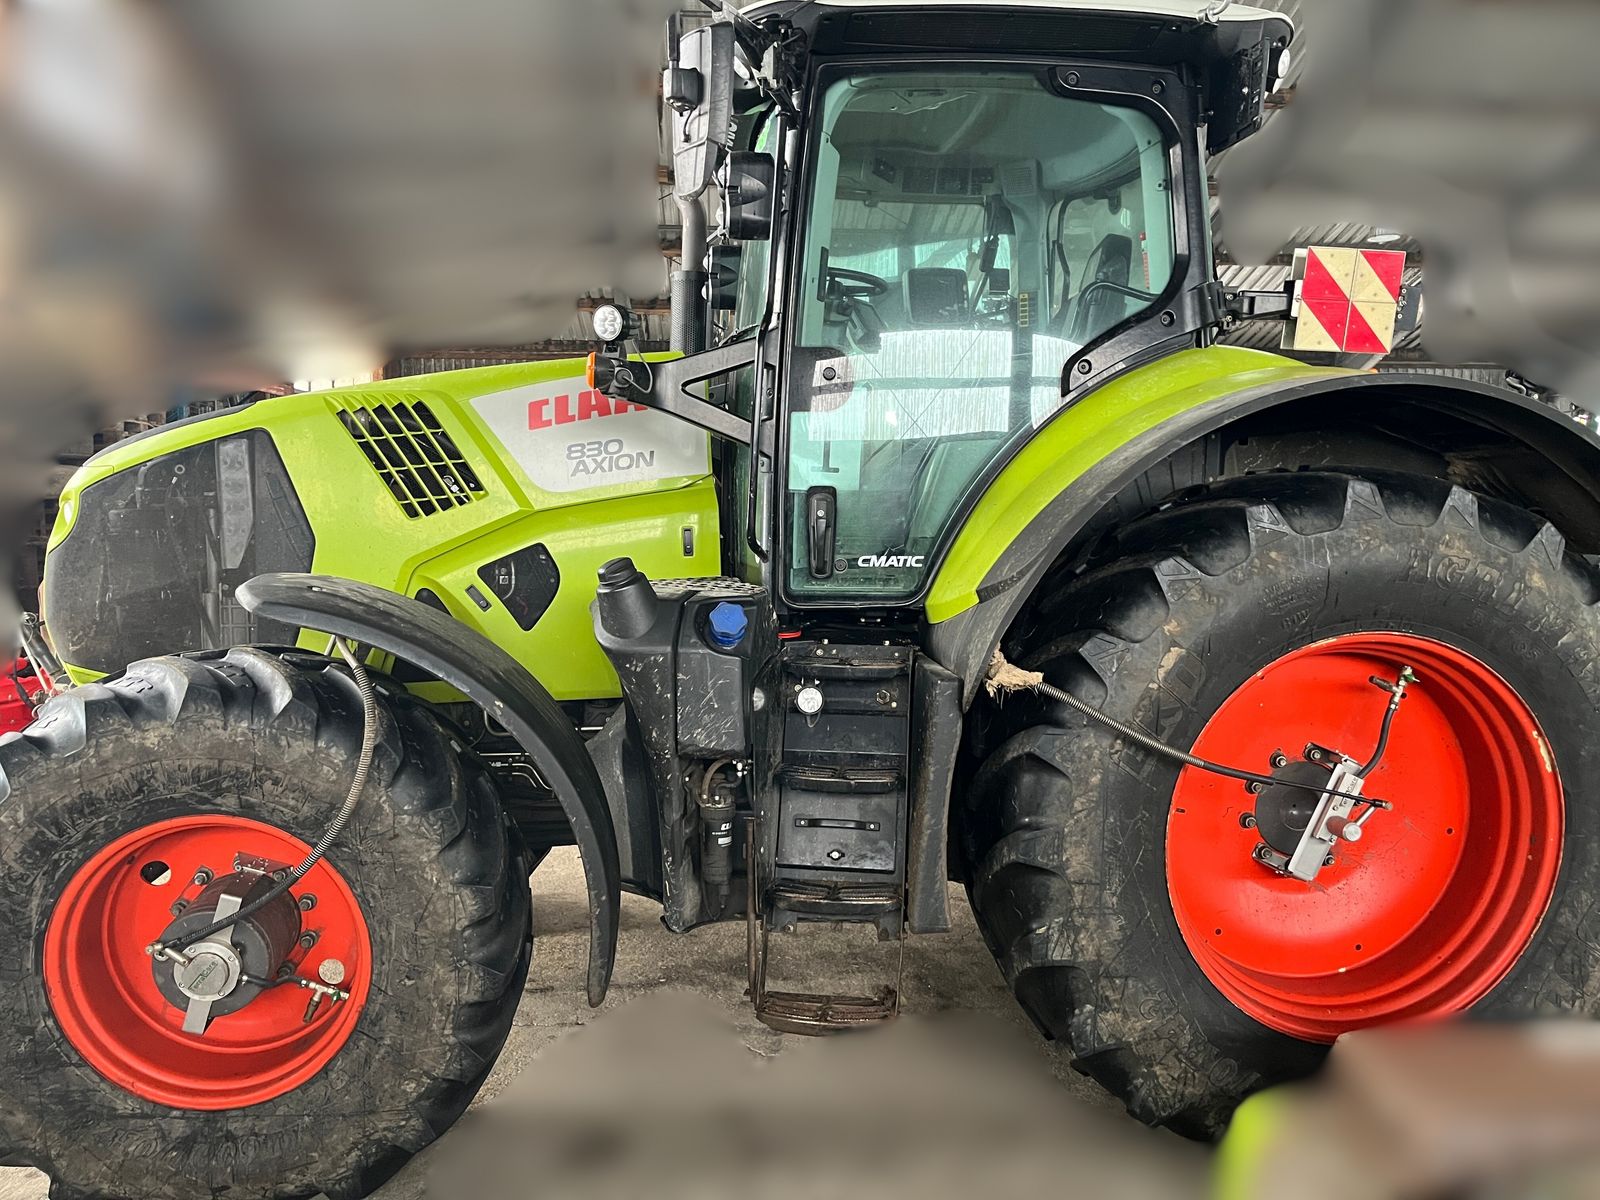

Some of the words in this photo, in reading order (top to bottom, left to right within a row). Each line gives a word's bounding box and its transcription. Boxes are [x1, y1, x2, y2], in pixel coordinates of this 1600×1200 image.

[528, 388, 648, 431] CLA
[566, 438, 624, 461] 830
[570, 450, 655, 477] AXION
[857, 554, 925, 568] CMATIC
